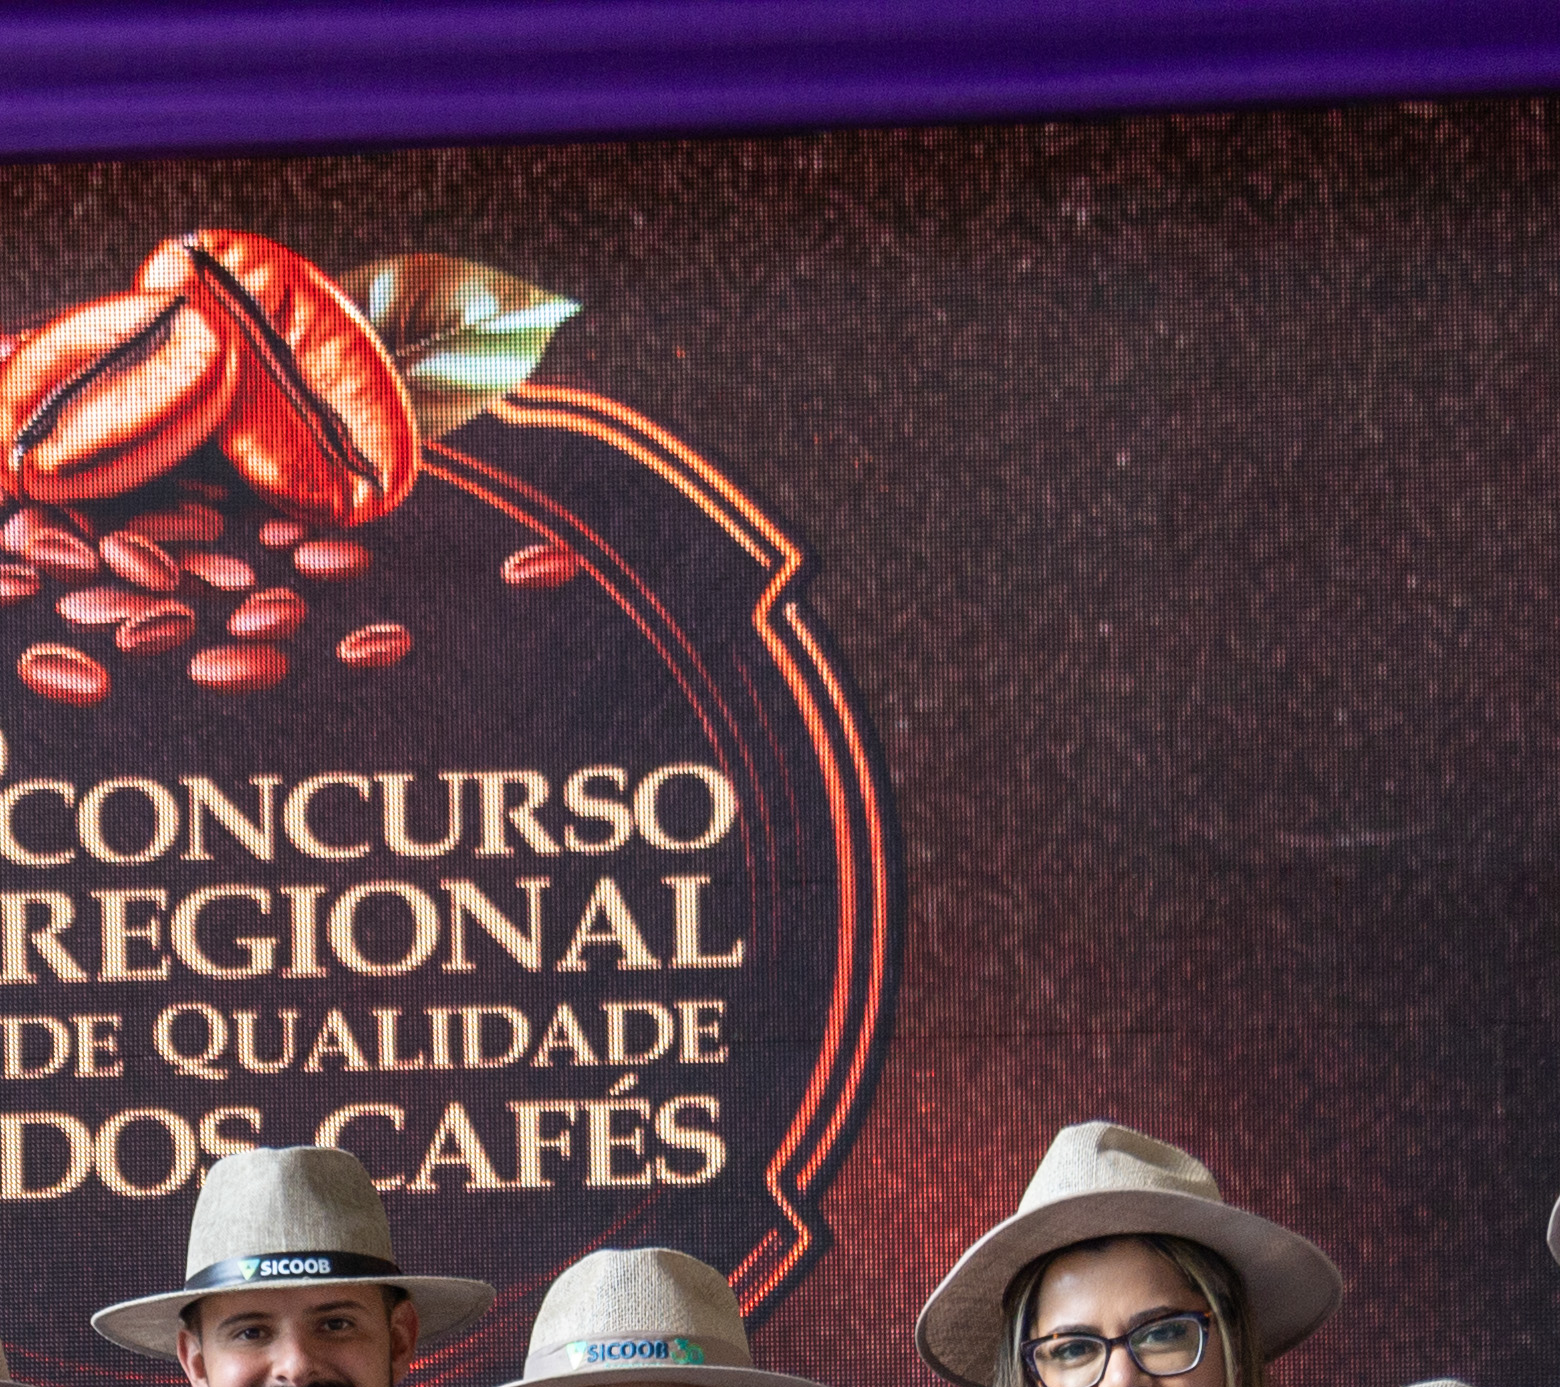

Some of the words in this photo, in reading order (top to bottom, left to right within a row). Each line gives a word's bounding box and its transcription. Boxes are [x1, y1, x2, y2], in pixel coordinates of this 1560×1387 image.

[0, 1014, 123, 1081] DE
[153, 1000, 729, 1076] QUALIDADE
[315, 1074, 727, 1193] CAFÉS
[260, 1258, 331, 1277] SICOOB
[587, 1340, 669, 1363] SICOOB
